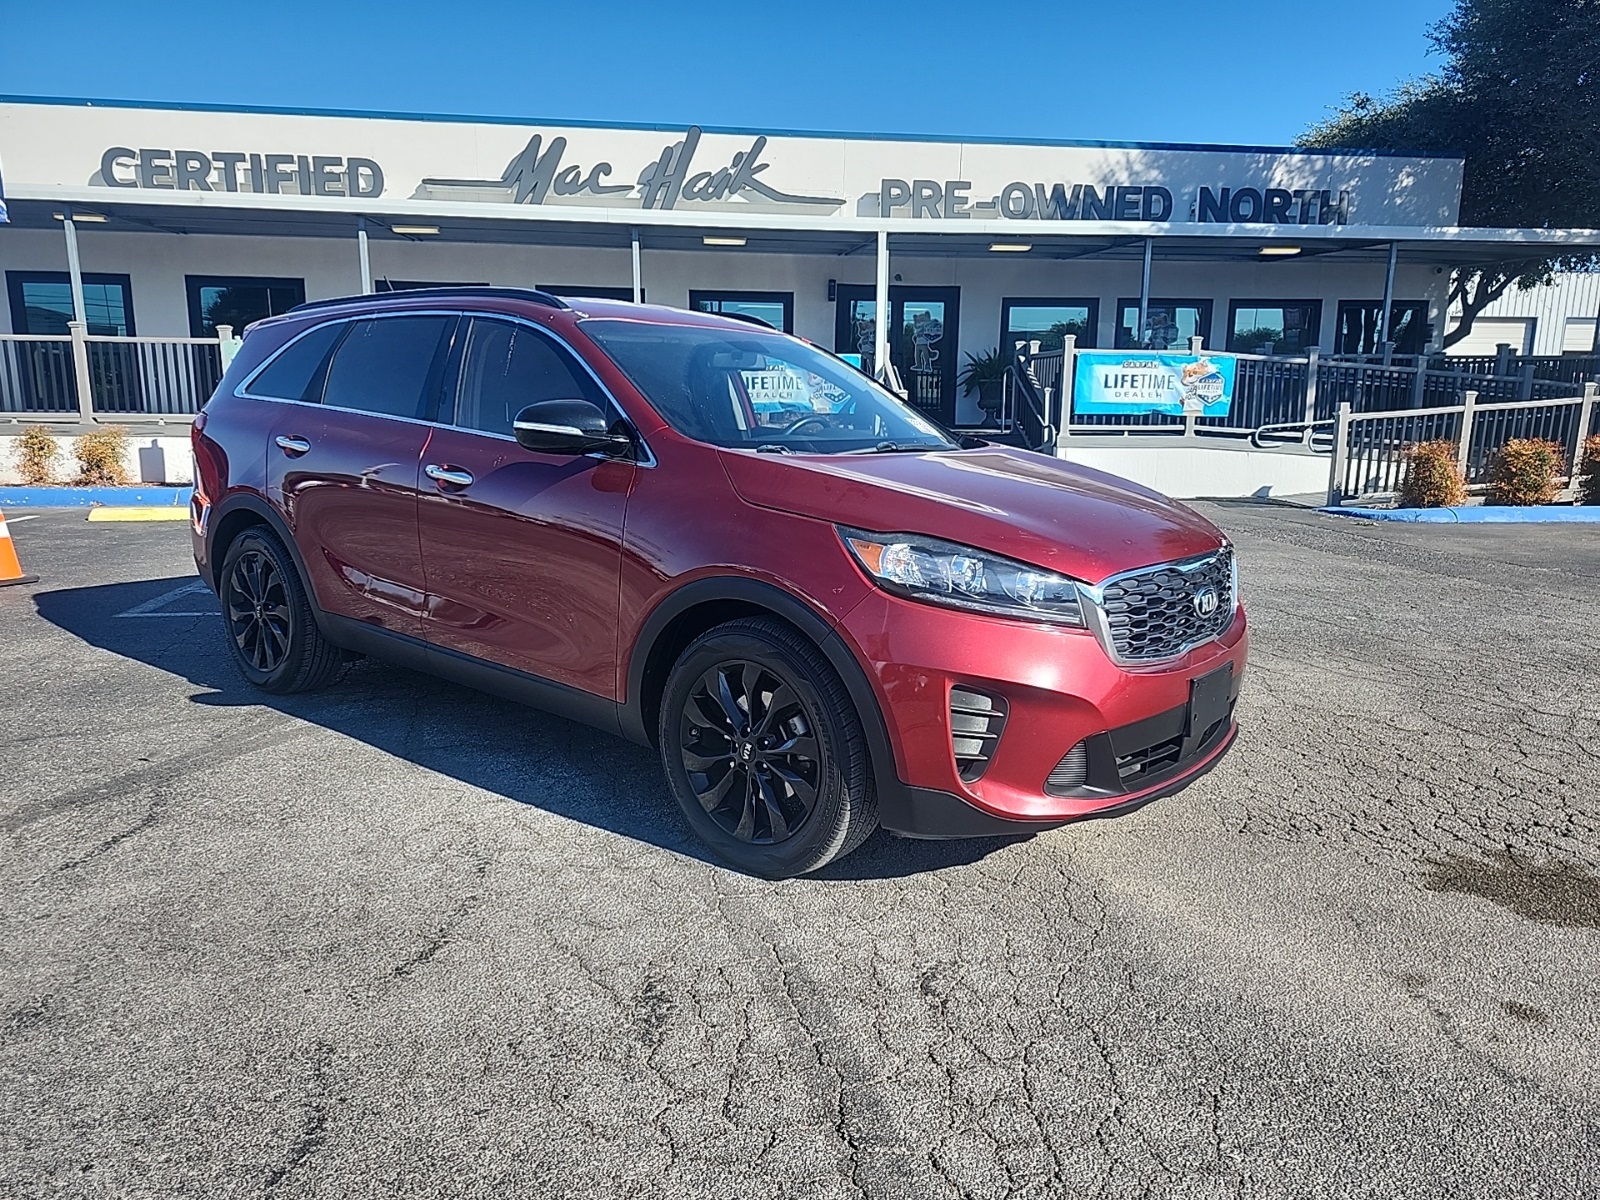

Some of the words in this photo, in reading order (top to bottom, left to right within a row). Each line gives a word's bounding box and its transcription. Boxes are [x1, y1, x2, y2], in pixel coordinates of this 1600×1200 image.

[101, 147, 384, 198] CERTIFIED
[422, 134, 635, 205] Mac
[638, 125, 847, 210] Haik
[1199, 186, 1351, 226] NORTH
[746, 375, 804, 391] IFETIME
[1104, 374, 1175, 390] LIFETIME
[743, 743, 752, 760] KIA
